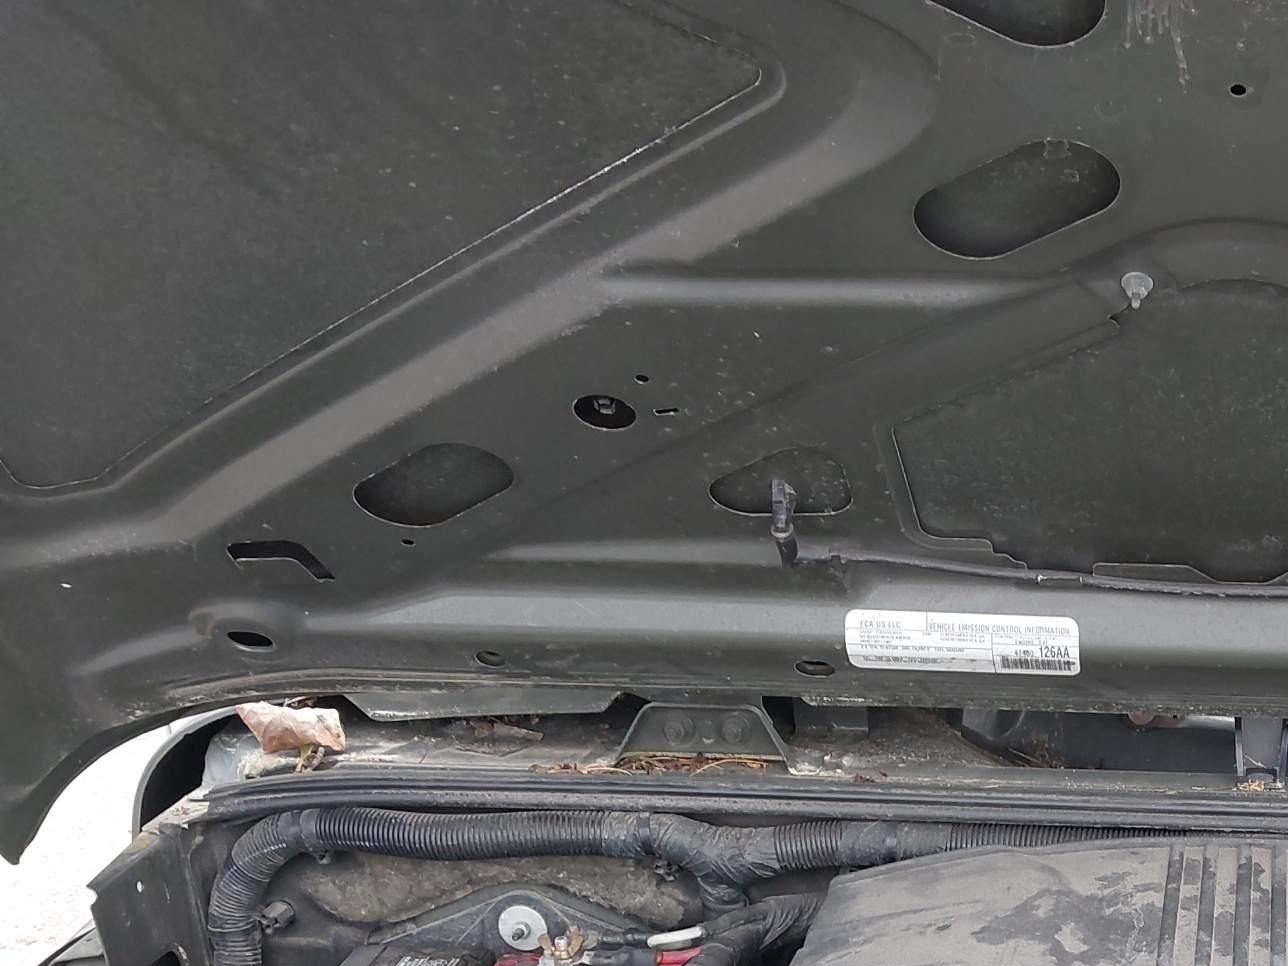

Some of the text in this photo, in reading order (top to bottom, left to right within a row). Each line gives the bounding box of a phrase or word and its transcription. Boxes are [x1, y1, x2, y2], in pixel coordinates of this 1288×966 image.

[876, 621, 886, 629] US
[928, 622, 1070, 635] VEHICLE EMISSION CONTROL INFORMATION
[1038, 645, 1070, 658] 126AA
